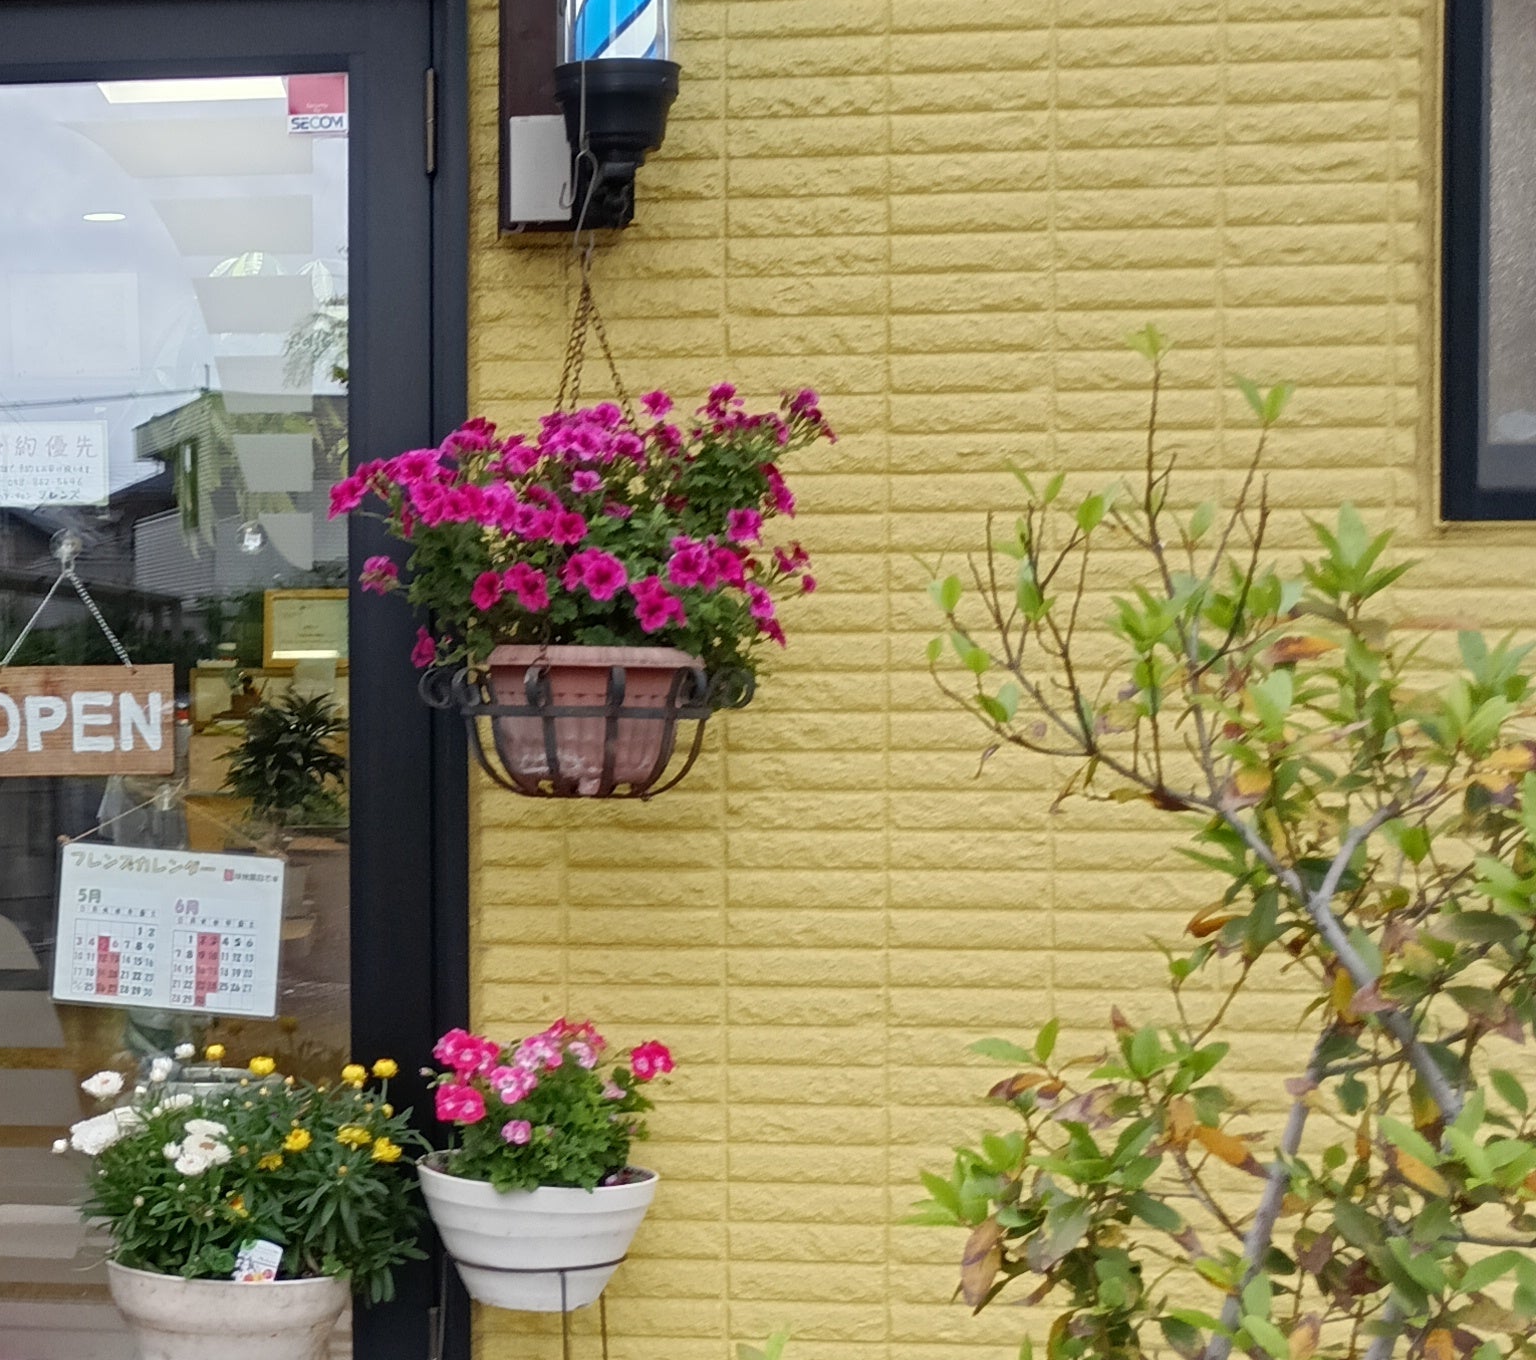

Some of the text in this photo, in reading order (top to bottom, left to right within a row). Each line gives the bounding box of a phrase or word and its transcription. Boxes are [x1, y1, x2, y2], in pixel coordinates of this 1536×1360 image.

[291, 115, 343, 130] SECOM
[78, 888, 102, 904] 5月
[175, 898, 199, 915] 6月
